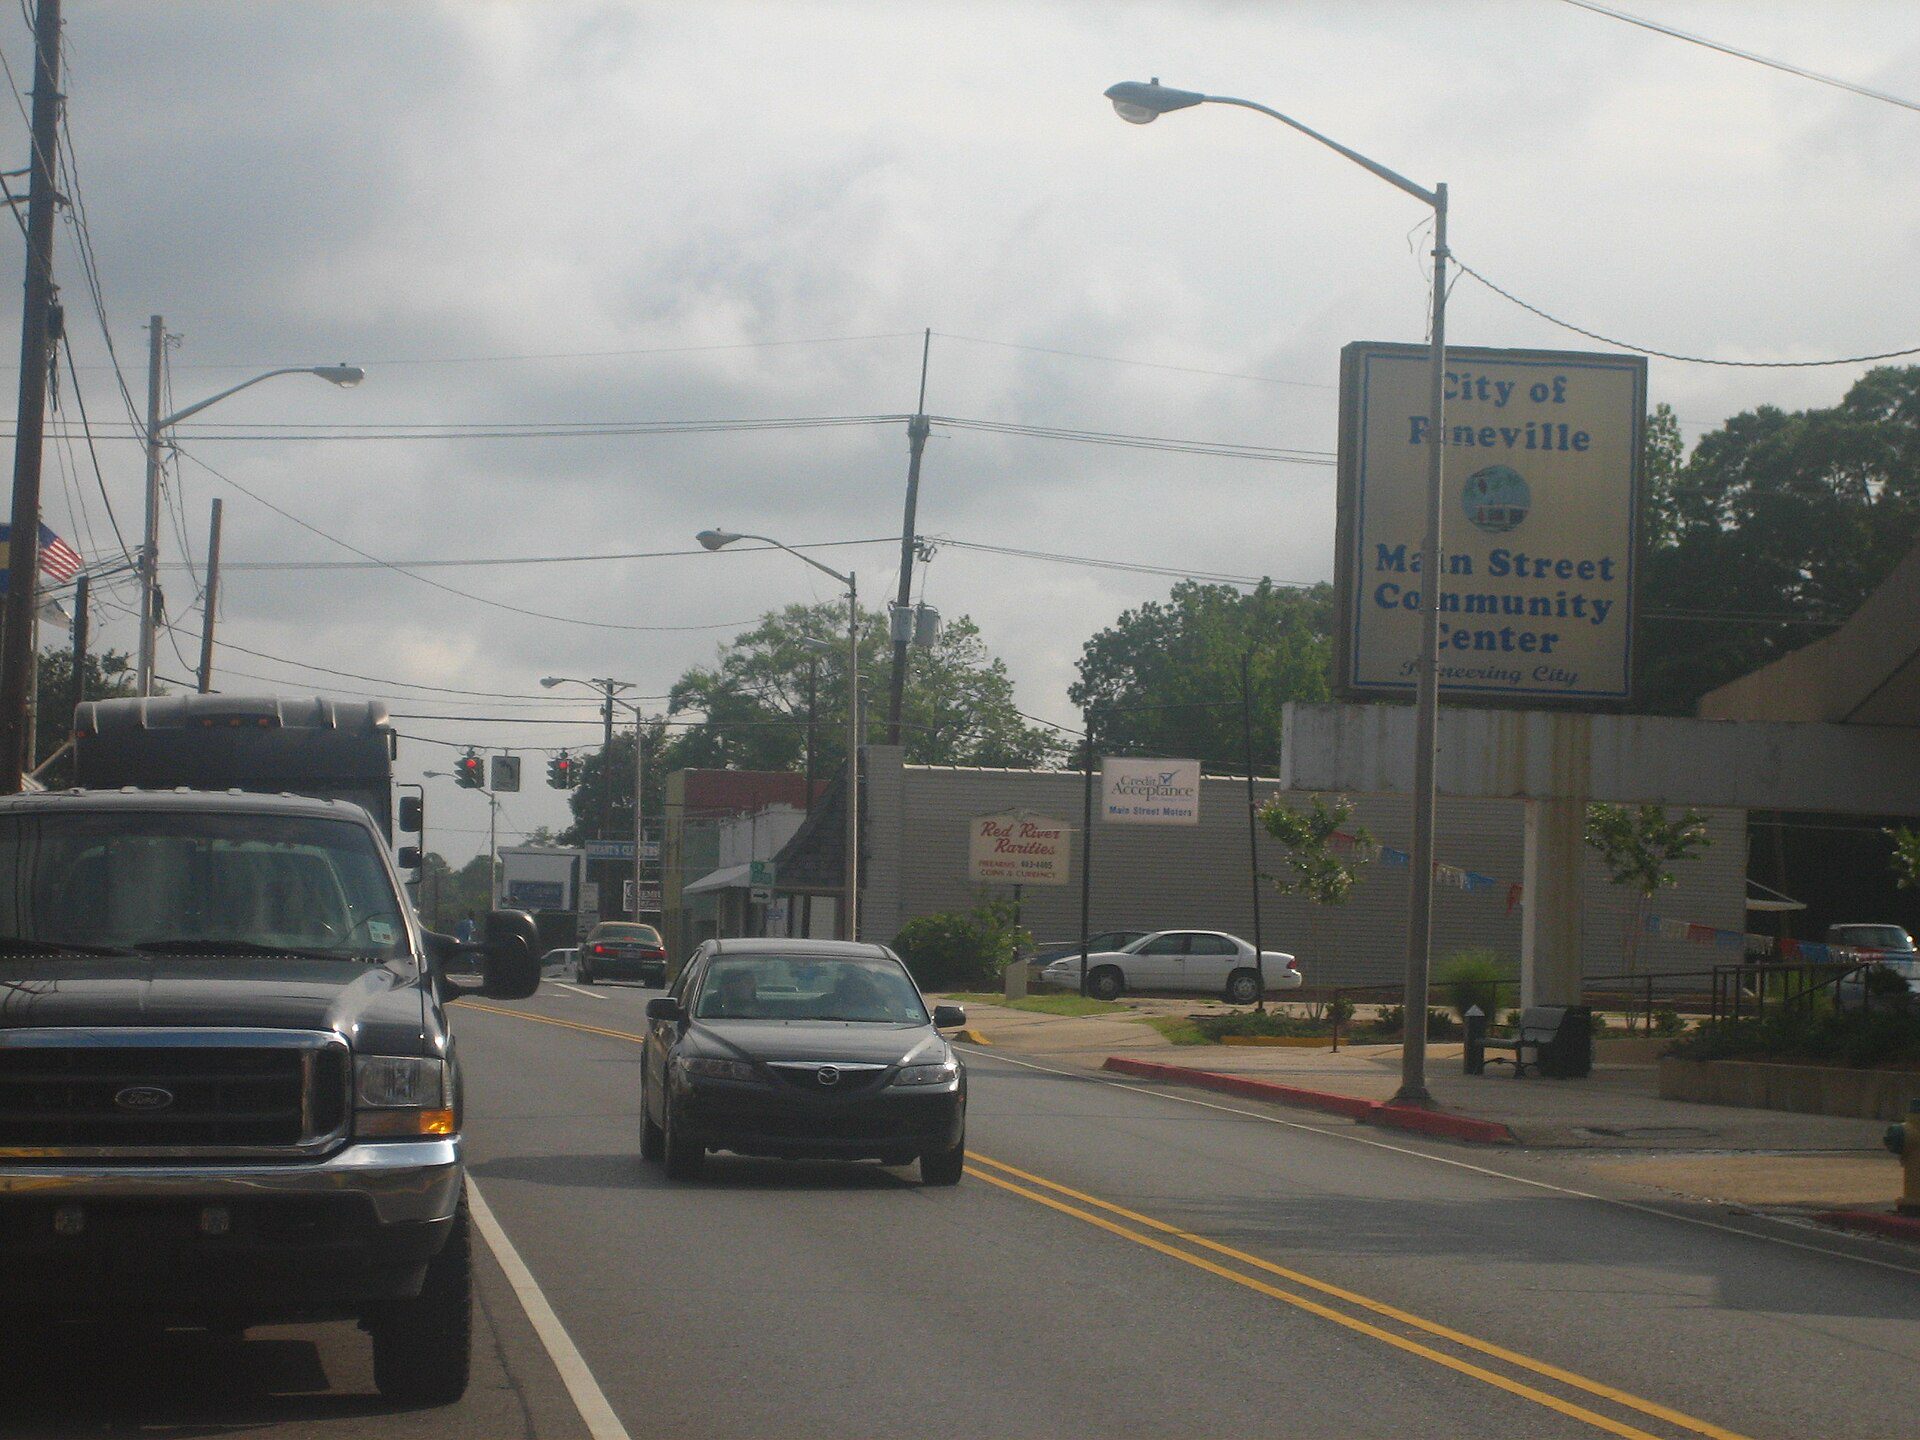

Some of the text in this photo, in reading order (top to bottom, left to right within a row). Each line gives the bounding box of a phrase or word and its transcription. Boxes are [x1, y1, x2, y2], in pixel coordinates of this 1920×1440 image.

[1529, 375, 1568, 404] of
[1408, 415, 1592, 452] Pneville
[1376, 543, 1616, 581] Man Street
[1532, 664, 1580, 688] City
[1111, 782, 1193, 801] Acceptance
[1109, 805, 1192, 817] Main Street Motors
[980, 821, 1061, 840] Red River
[994, 837, 1056, 856] Rarities
